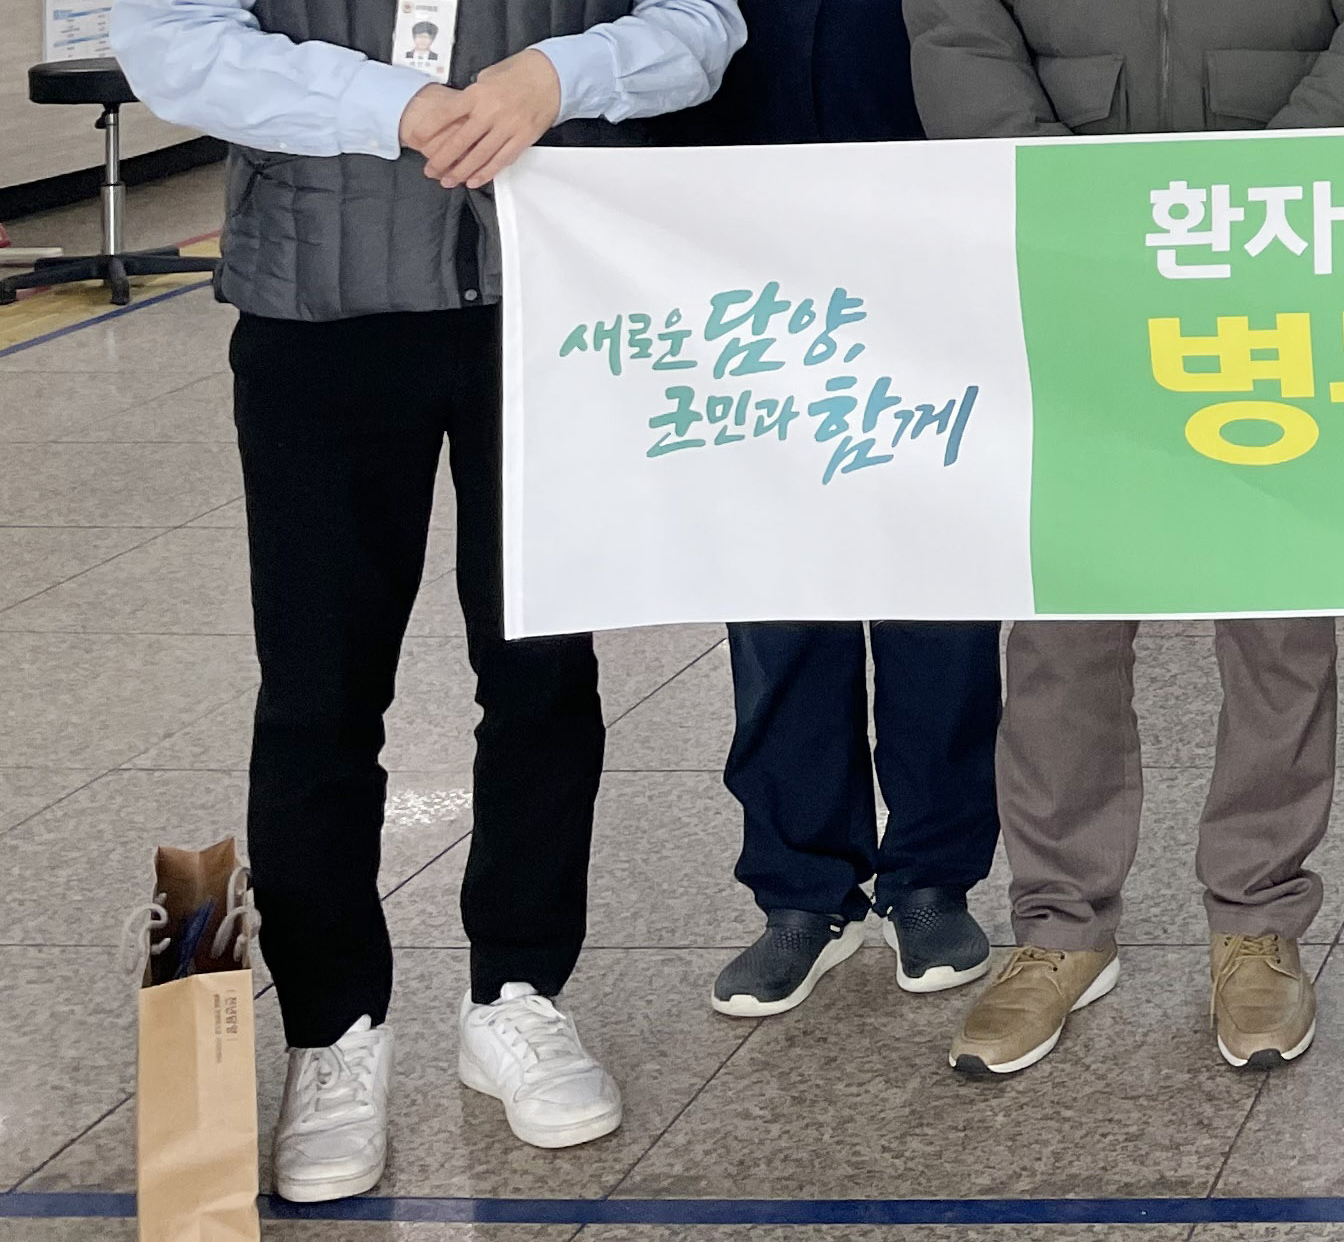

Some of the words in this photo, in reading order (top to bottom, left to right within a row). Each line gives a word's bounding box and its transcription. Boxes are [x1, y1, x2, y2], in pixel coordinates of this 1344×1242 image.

[559, 308, 698, 376] 새로운
[646, 385, 800, 458] 군민과
[807, 376, 979, 485] 함께
